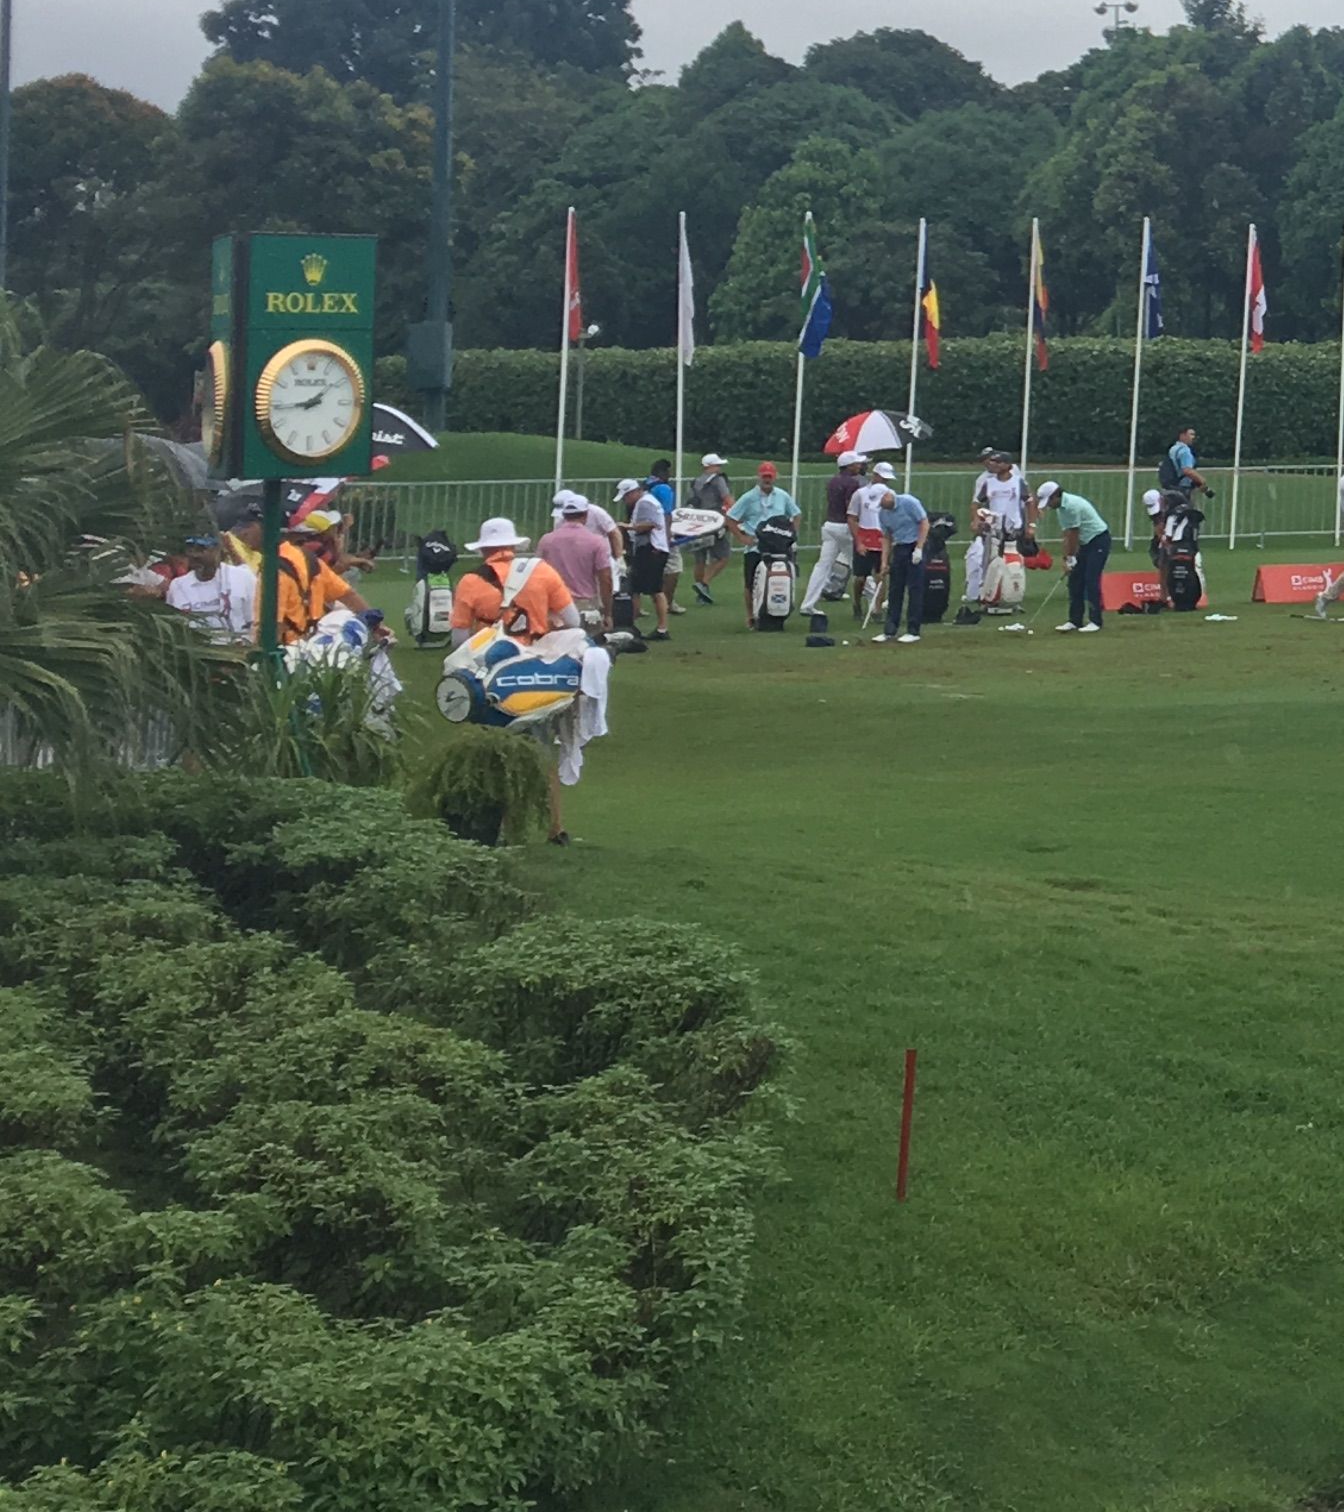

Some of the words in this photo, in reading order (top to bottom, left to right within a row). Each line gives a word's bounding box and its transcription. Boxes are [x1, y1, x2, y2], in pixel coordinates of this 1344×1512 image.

[265, 292, 360, 314] ROLEX
[294, 378, 327, 387] ROLEX
[495, 671, 579, 687] cobra
